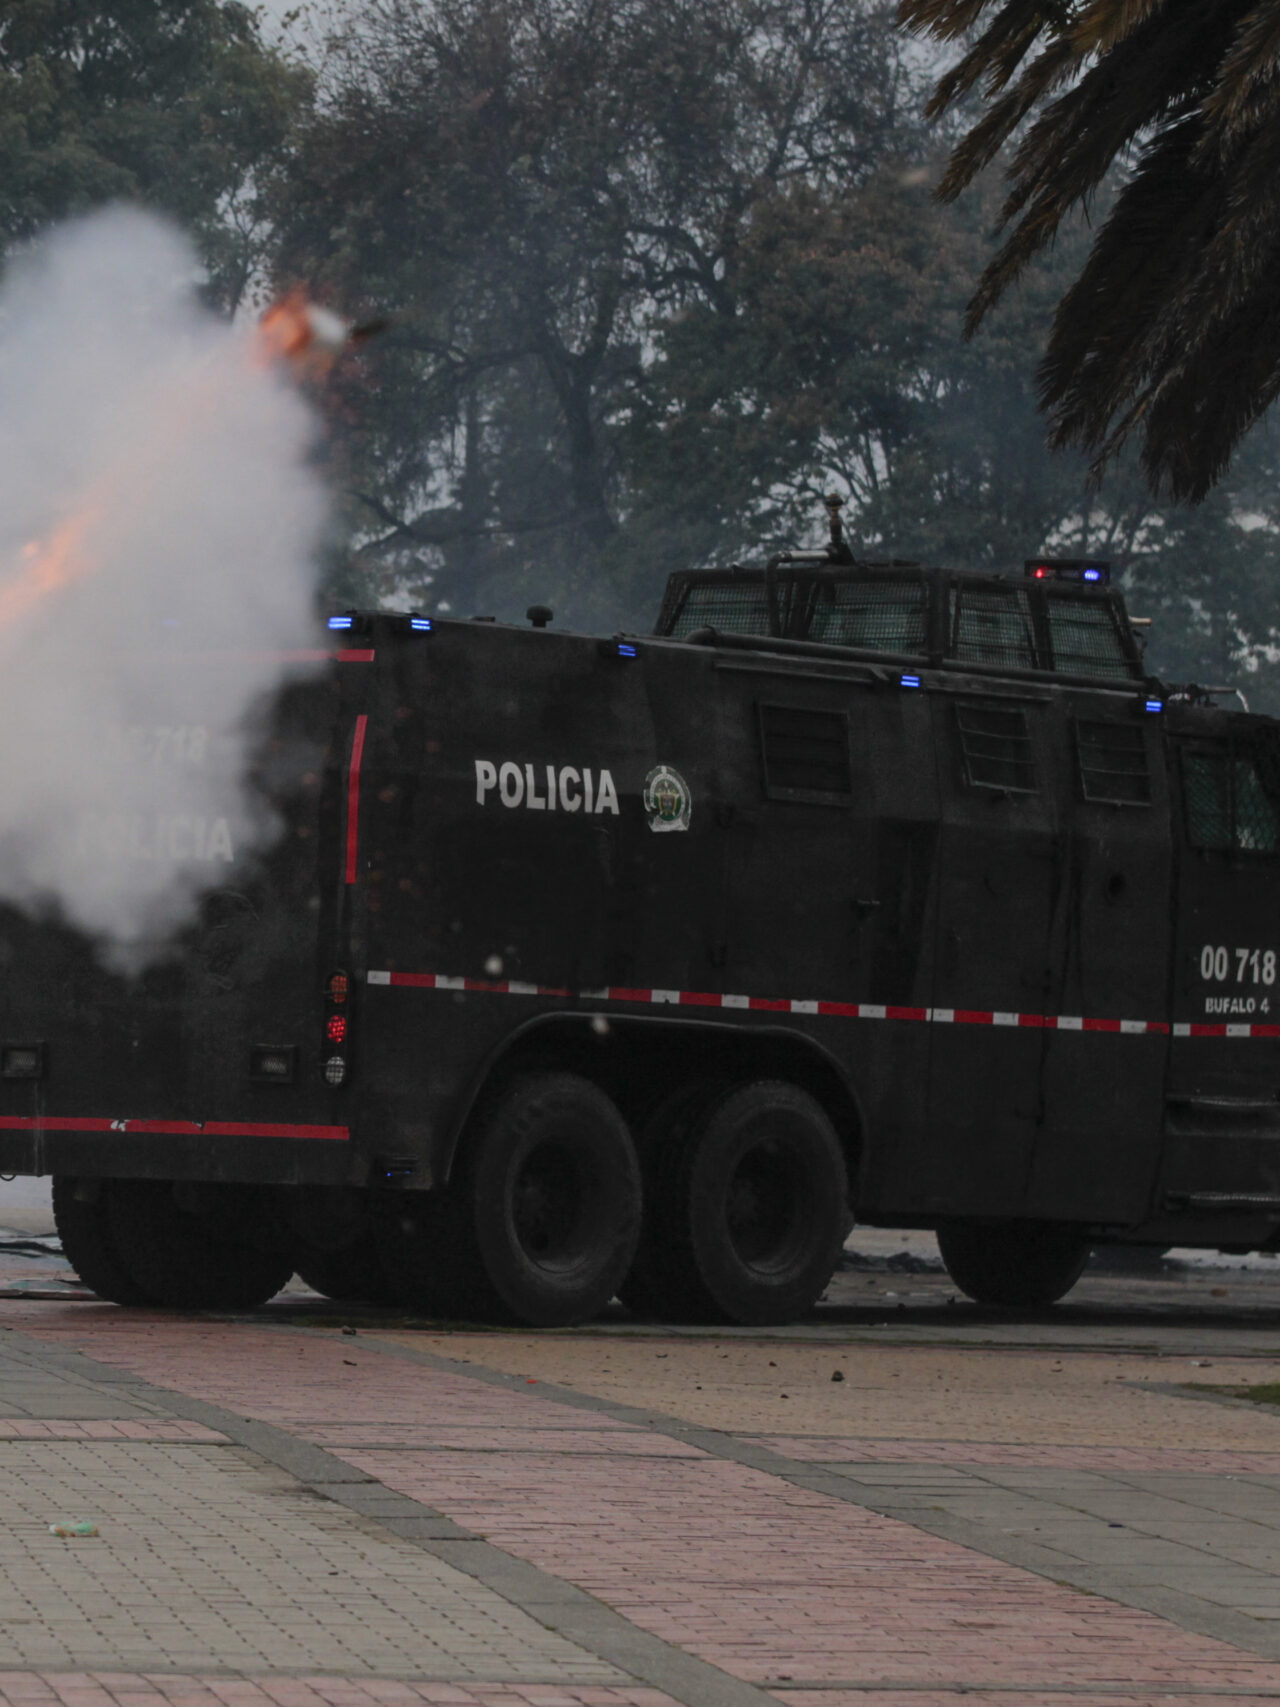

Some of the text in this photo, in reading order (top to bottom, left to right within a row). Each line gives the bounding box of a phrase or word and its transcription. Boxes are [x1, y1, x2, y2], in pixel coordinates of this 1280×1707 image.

[475, 760, 620, 815] POLICIA
[78, 815, 234, 862] LICIA
[1201, 945, 1276, 985] 00 718
[1205, 998, 1270, 1014] BUFALO 4
